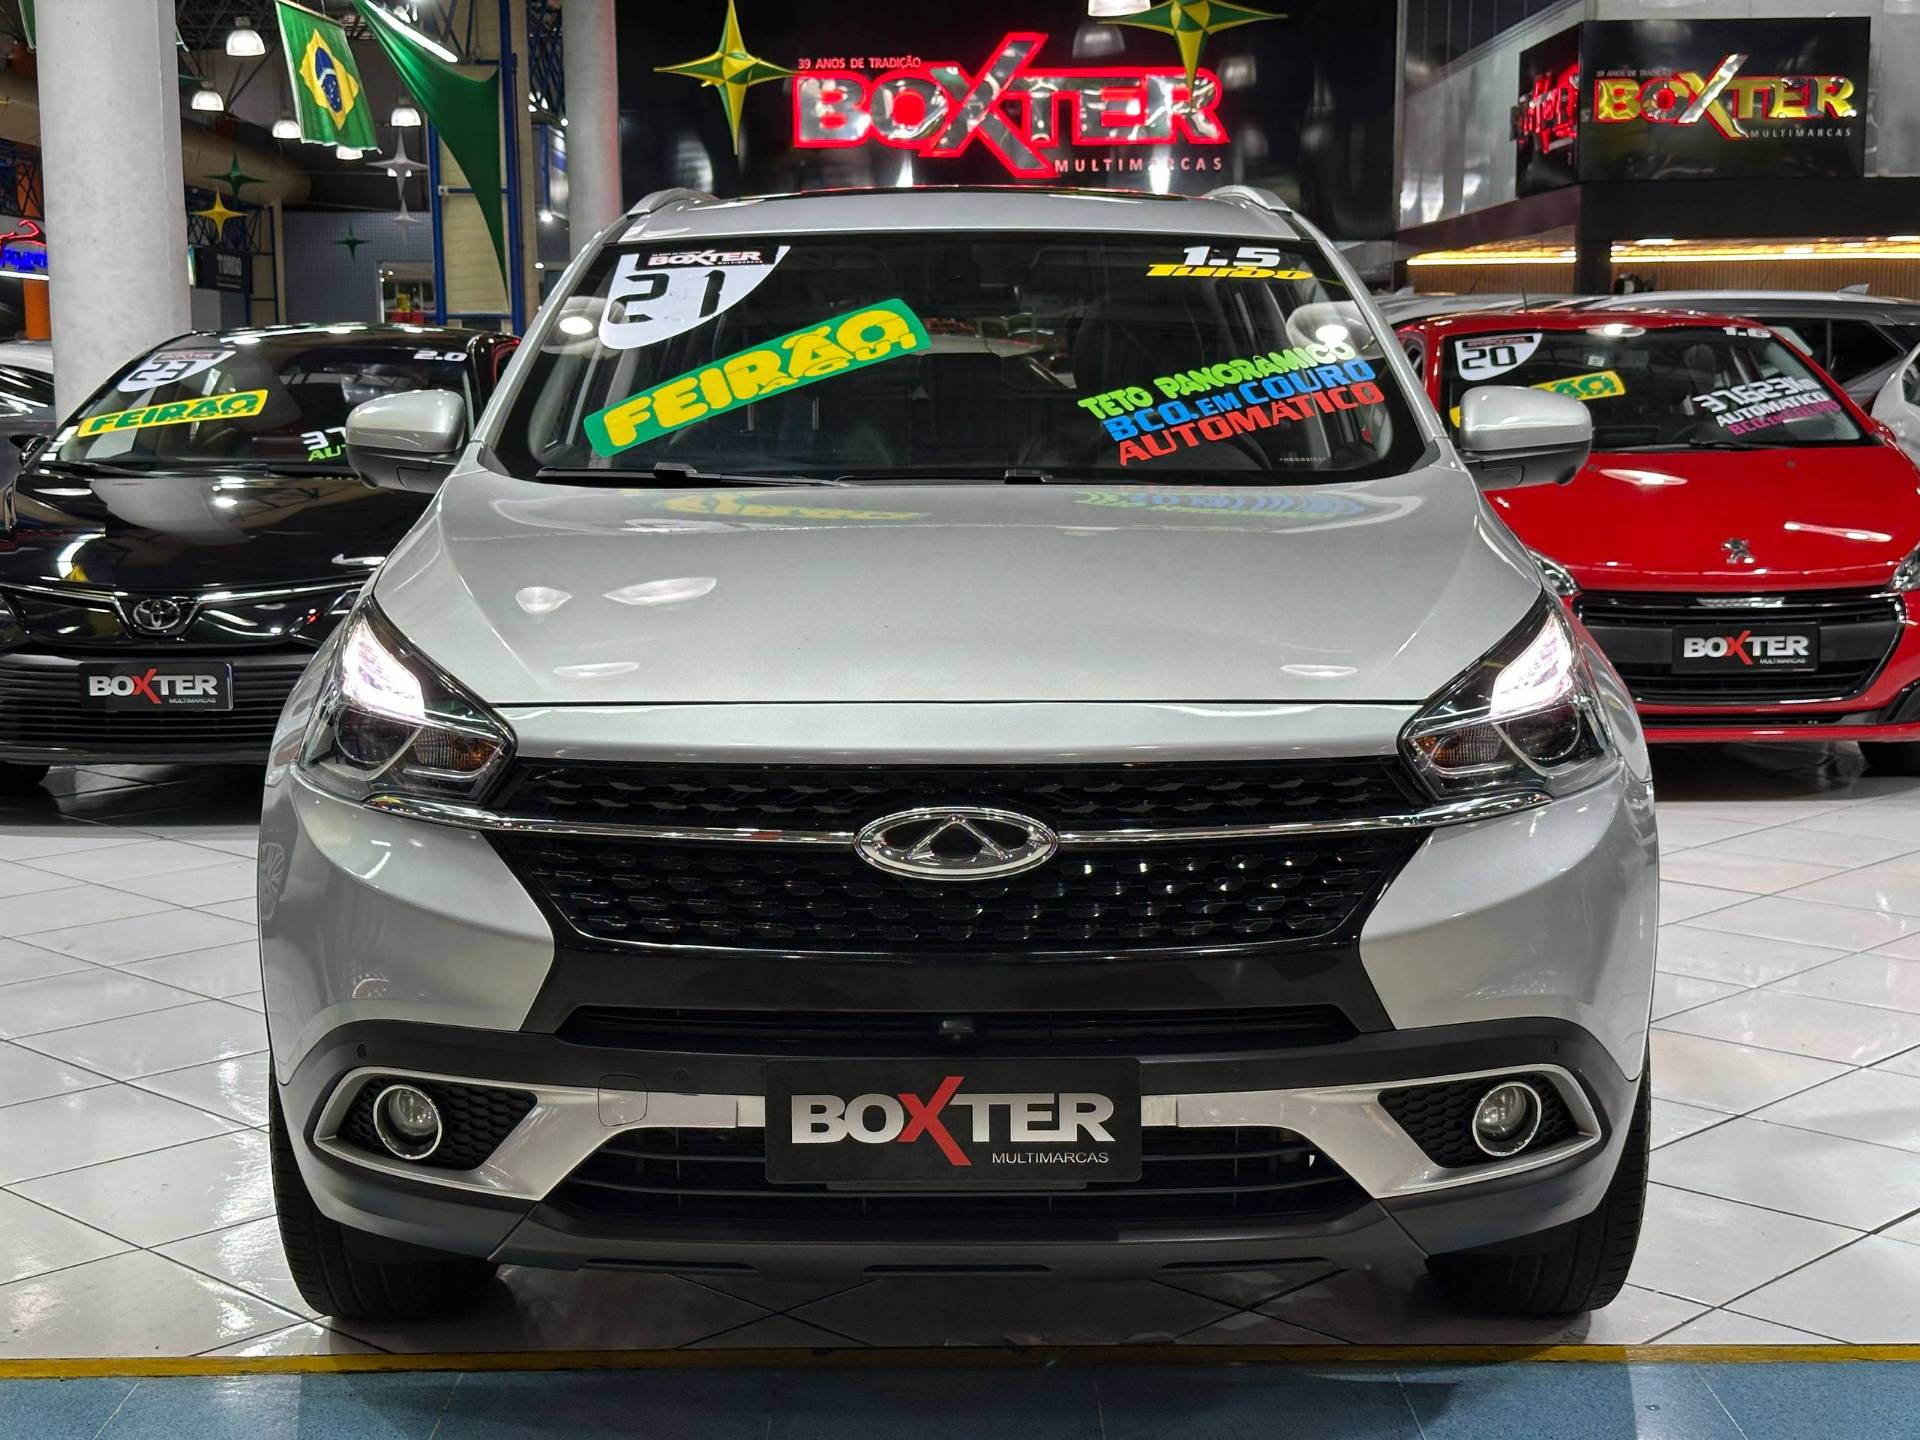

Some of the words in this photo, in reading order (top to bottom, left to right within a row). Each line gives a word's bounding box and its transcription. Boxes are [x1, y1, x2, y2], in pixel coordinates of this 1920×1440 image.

[798, 57, 811, 70] 39
[815, 57, 846, 70] ANOS
[850, 57, 864, 69] DE
[868, 54, 921, 70] TRADIÇÃO
[794, 32, 1229, 178] BOXTER
[1594, 53, 1857, 140] BOXTER
[1750, 127, 1852, 138] MULTIMARCAS
[1054, 157, 1223, 173] MULTIMARCAS
[647, 249, 761, 266] BOXTER
[1183, 246, 1281, 267] 1.5
[607, 269, 726, 325] 21
[413, 350, 468, 362] 2.0
[1462, 346, 1518, 370] 20
[603, 310, 911, 447] FEIRÃO
[1077, 386, 1154, 420] TETO
[1153, 342, 1356, 399] PANORÂMICO
[1199, 393, 1242, 417] EM
[1238, 356, 1377, 405] COURO
[1683, 629, 1810, 666] BOXTER
[88, 668, 219, 705] BOXTER
[791, 1076, 1116, 1167] BOXTER
[991, 1151, 1109, 1164] MULTIMARCAS
